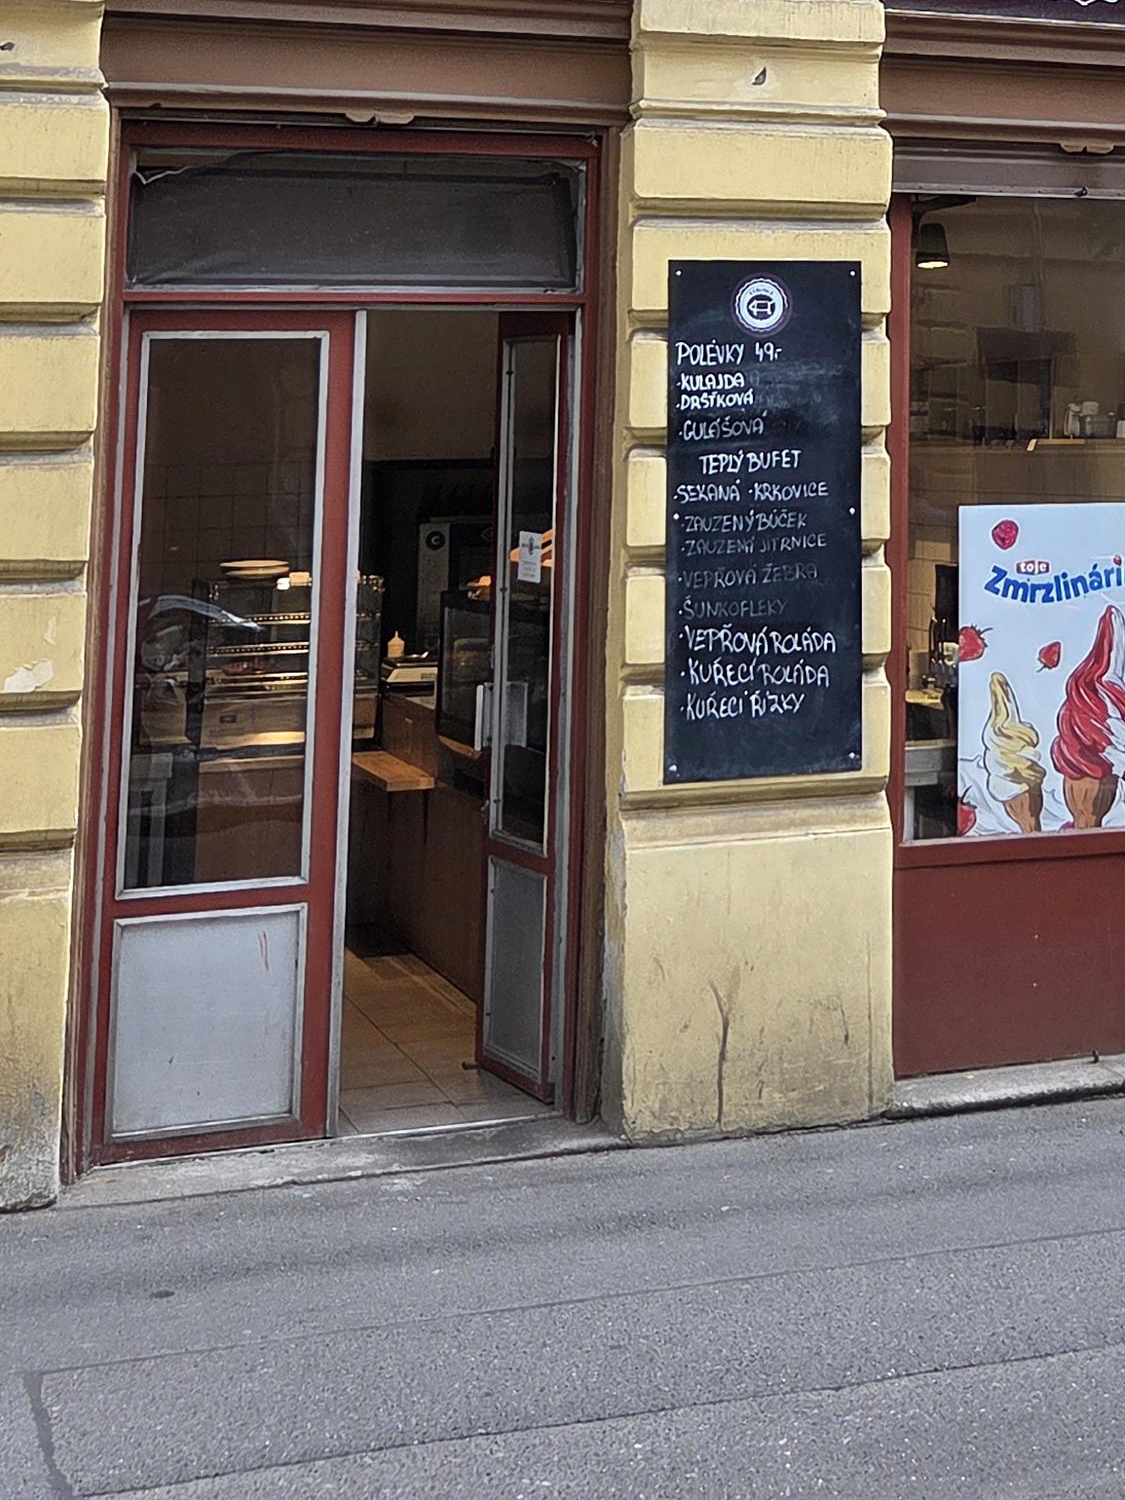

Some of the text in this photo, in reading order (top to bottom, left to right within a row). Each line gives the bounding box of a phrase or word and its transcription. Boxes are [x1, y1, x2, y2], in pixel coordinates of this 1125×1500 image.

[675, 339, 744, 366] POLÉVKY
[680, 372, 745, 391] KULAJDA
[683, 410, 768, 441] GULÁŠOVÁ
[699, 449, 802, 475] TEPLÝ BUFET
[676, 479, 829, 504] SEKANÁ KRKOVICE
[760, 533, 828, 553] JITRNICE
[682, 563, 757, 589] VEPŘOVÁ
[683, 594, 788, 620] ŠUNKOFLEKY
[685, 623, 836, 656] VEPŘOVÁ ROLÁDA
[688, 656, 830, 688] KUŘECÍ ROLÁDA
